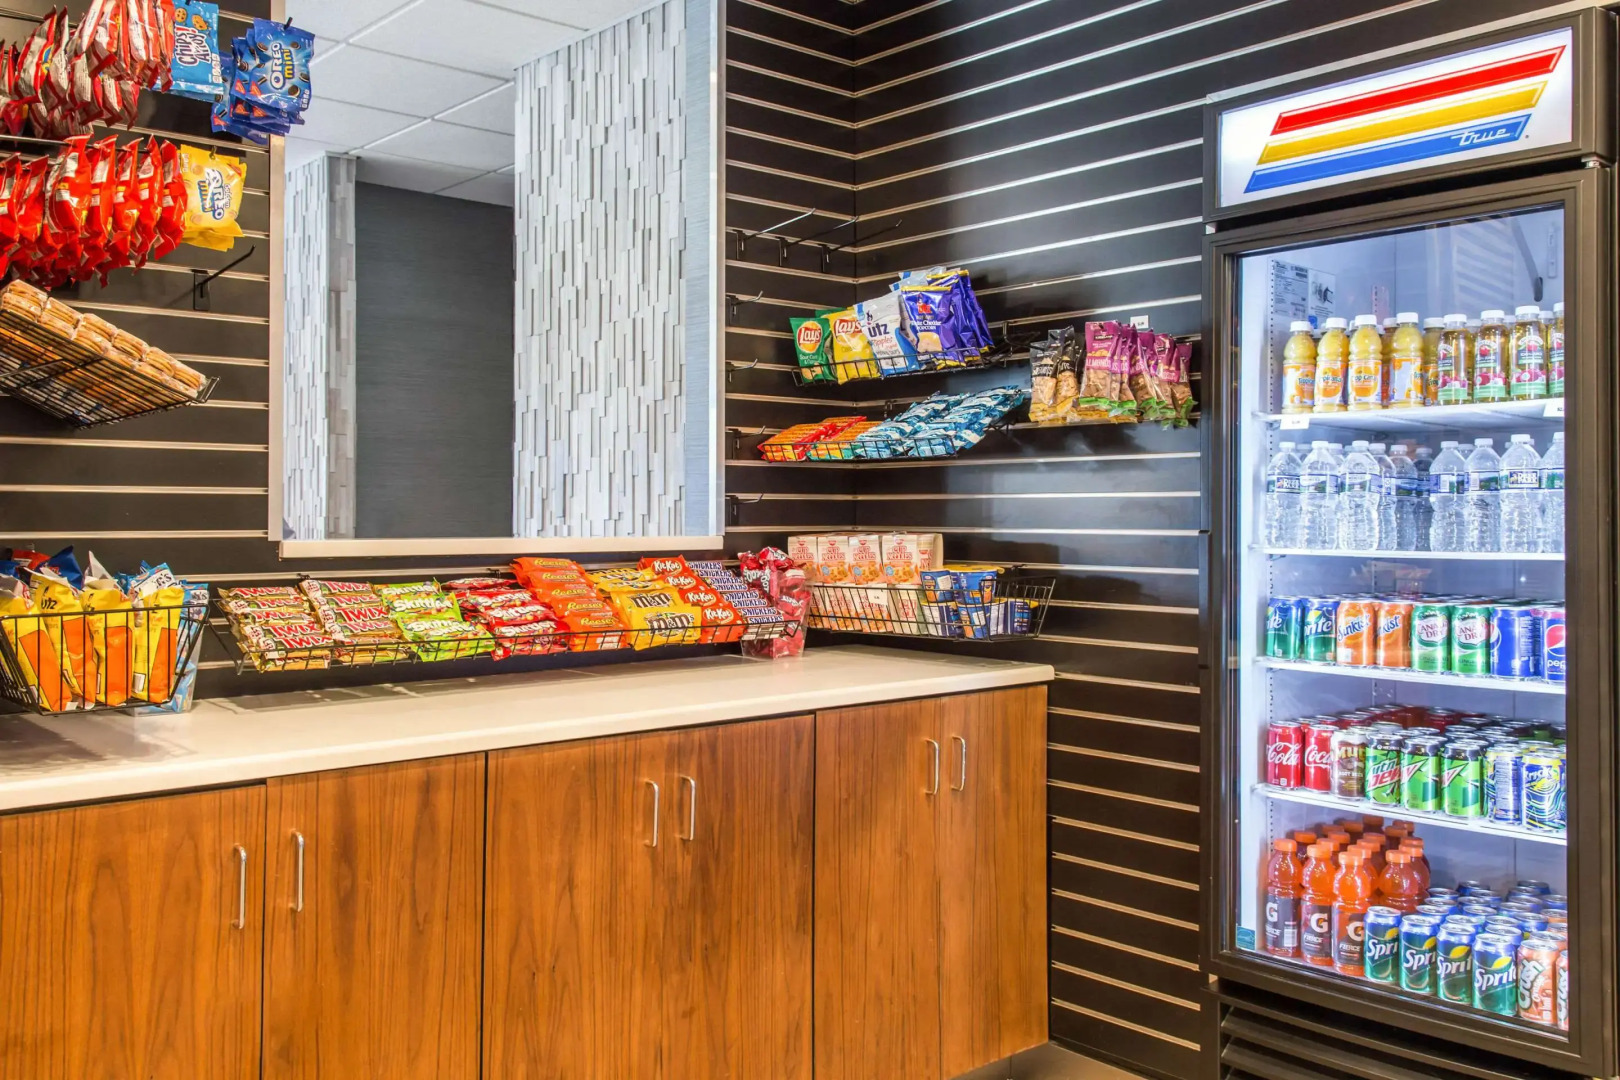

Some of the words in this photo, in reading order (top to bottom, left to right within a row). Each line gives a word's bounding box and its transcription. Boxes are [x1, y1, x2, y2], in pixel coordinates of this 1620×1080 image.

[270, 43, 285, 89] OREO
[281, 48, 293, 78] mini
[1450, 128, 1511, 146] True
[206, 168, 224, 219] OREO
[799, 327, 821, 344] Lay's
[835, 319, 861, 336] Lay's
[688, 561, 722, 570] SNICKERS
[320, 580, 370, 591] TWIX
[725, 591, 759, 600] SNICKERS
[732, 599, 767, 608] SNICKERS
[334, 607, 389, 623] TWIX
[742, 607, 777, 616] SNICKERS
[263, 624, 321, 638] TWIX
[274, 635, 334, 649] TWIX
[1267, 742, 1302, 766] Cola
[1266, 902, 1278, 922] G
[1310, 913, 1329, 933] G
[1347, 921, 1365, 942] G
